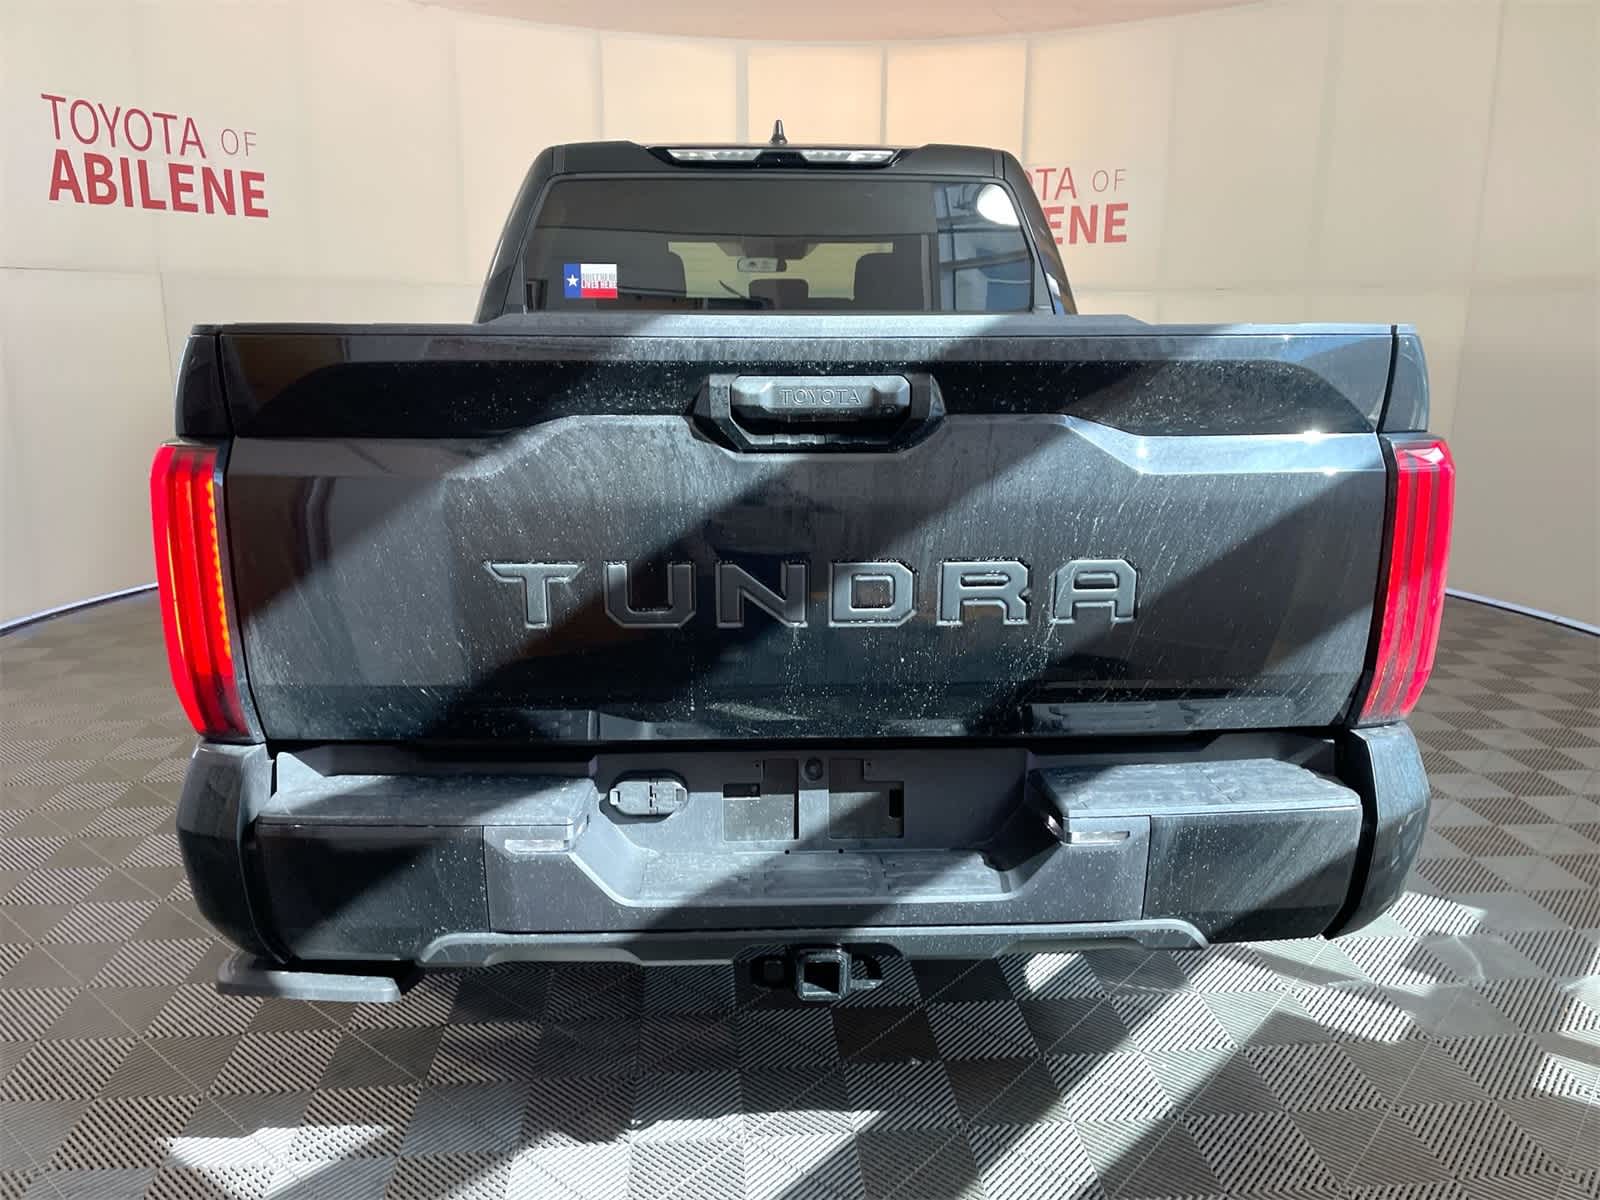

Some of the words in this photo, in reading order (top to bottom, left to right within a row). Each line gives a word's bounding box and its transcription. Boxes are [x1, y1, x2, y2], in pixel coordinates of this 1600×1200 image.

[41, 93, 207, 159] TOYOTA
[221, 128, 257, 157] OF
[49, 148, 269, 218] ABILENE
[1092, 168, 1127, 193] OF
[780, 388, 863, 406] TOYOTA
[483, 558, 1139, 630] TUNDRA
